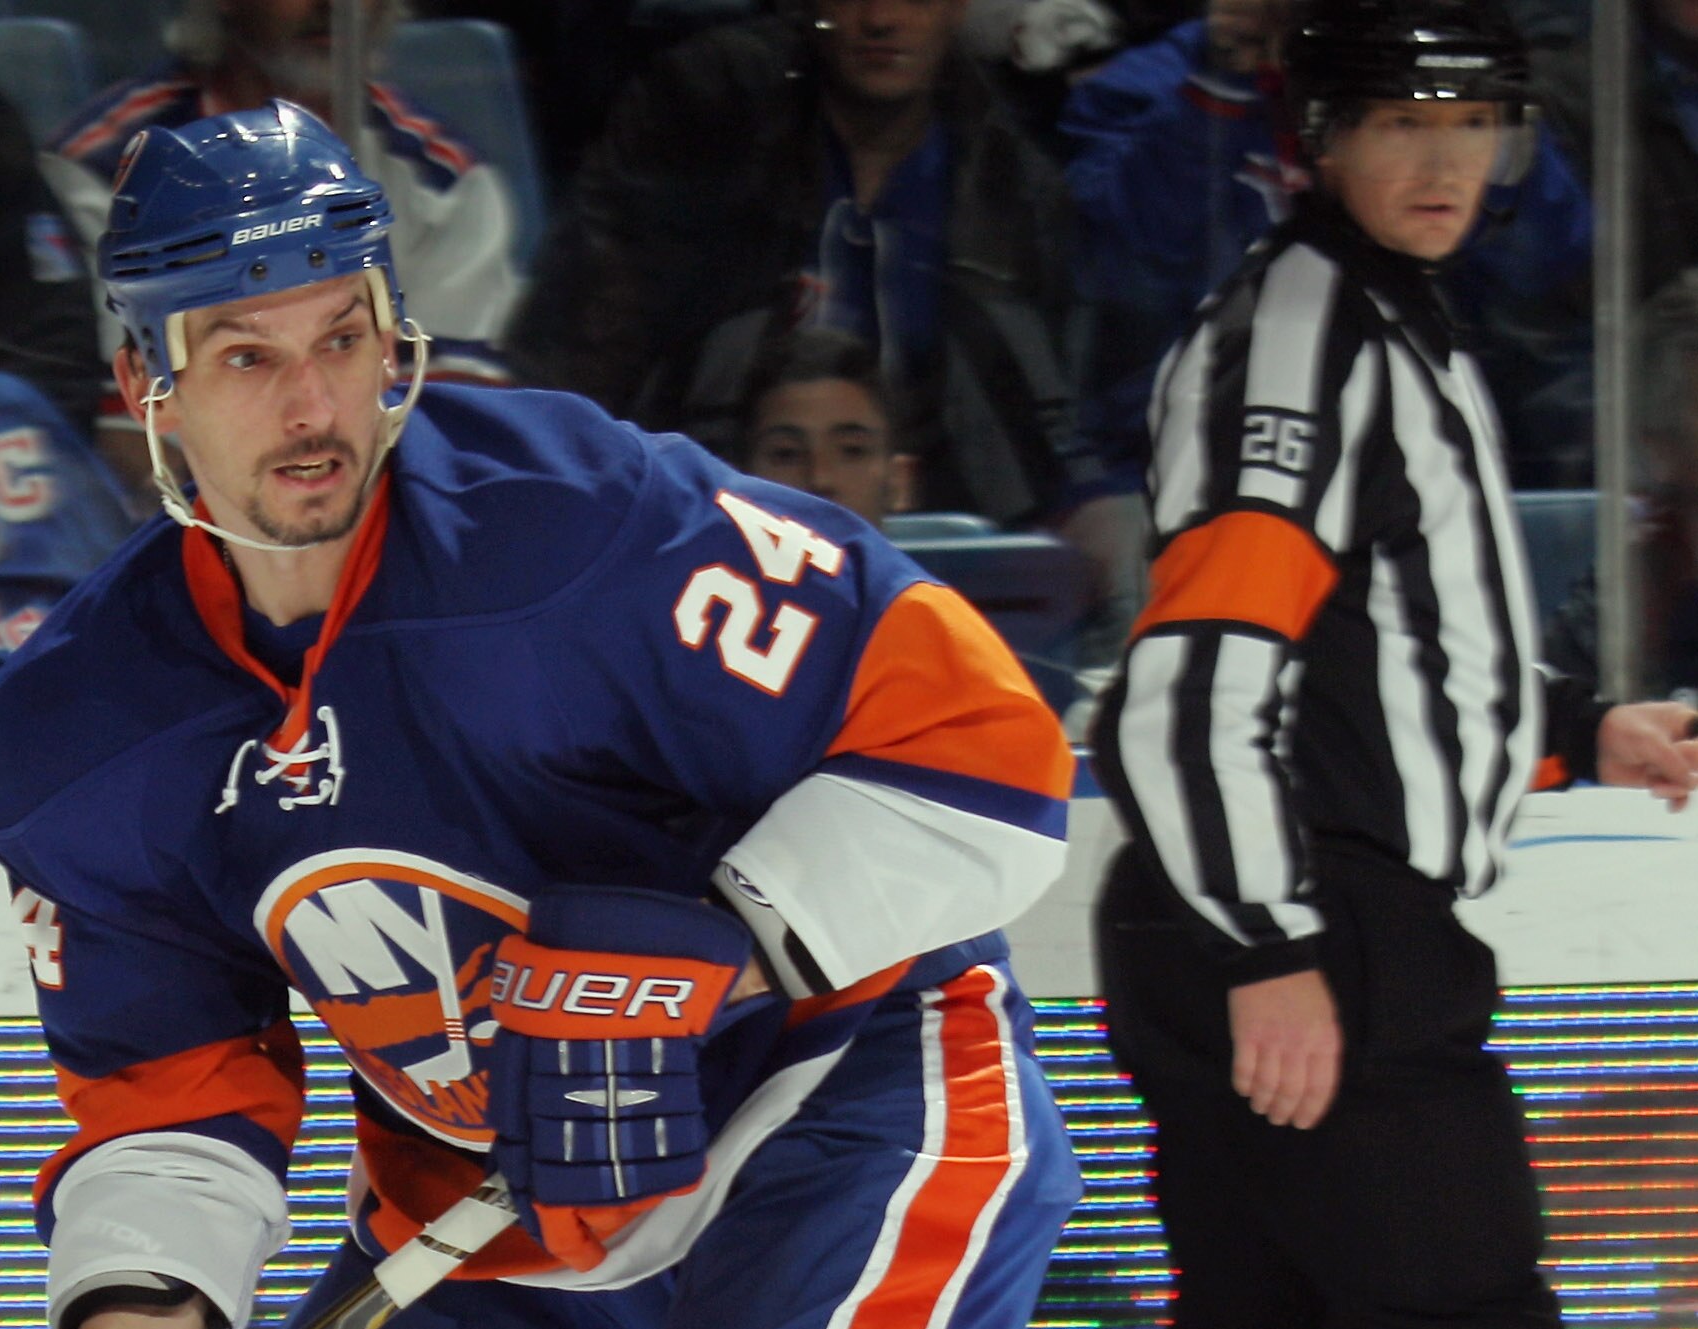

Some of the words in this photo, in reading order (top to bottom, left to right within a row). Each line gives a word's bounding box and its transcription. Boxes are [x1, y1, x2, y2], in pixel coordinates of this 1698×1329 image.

[231, 213, 323, 246] BAUER
[1240, 413, 1316, 473] 26
[671, 488, 846, 698] 24
